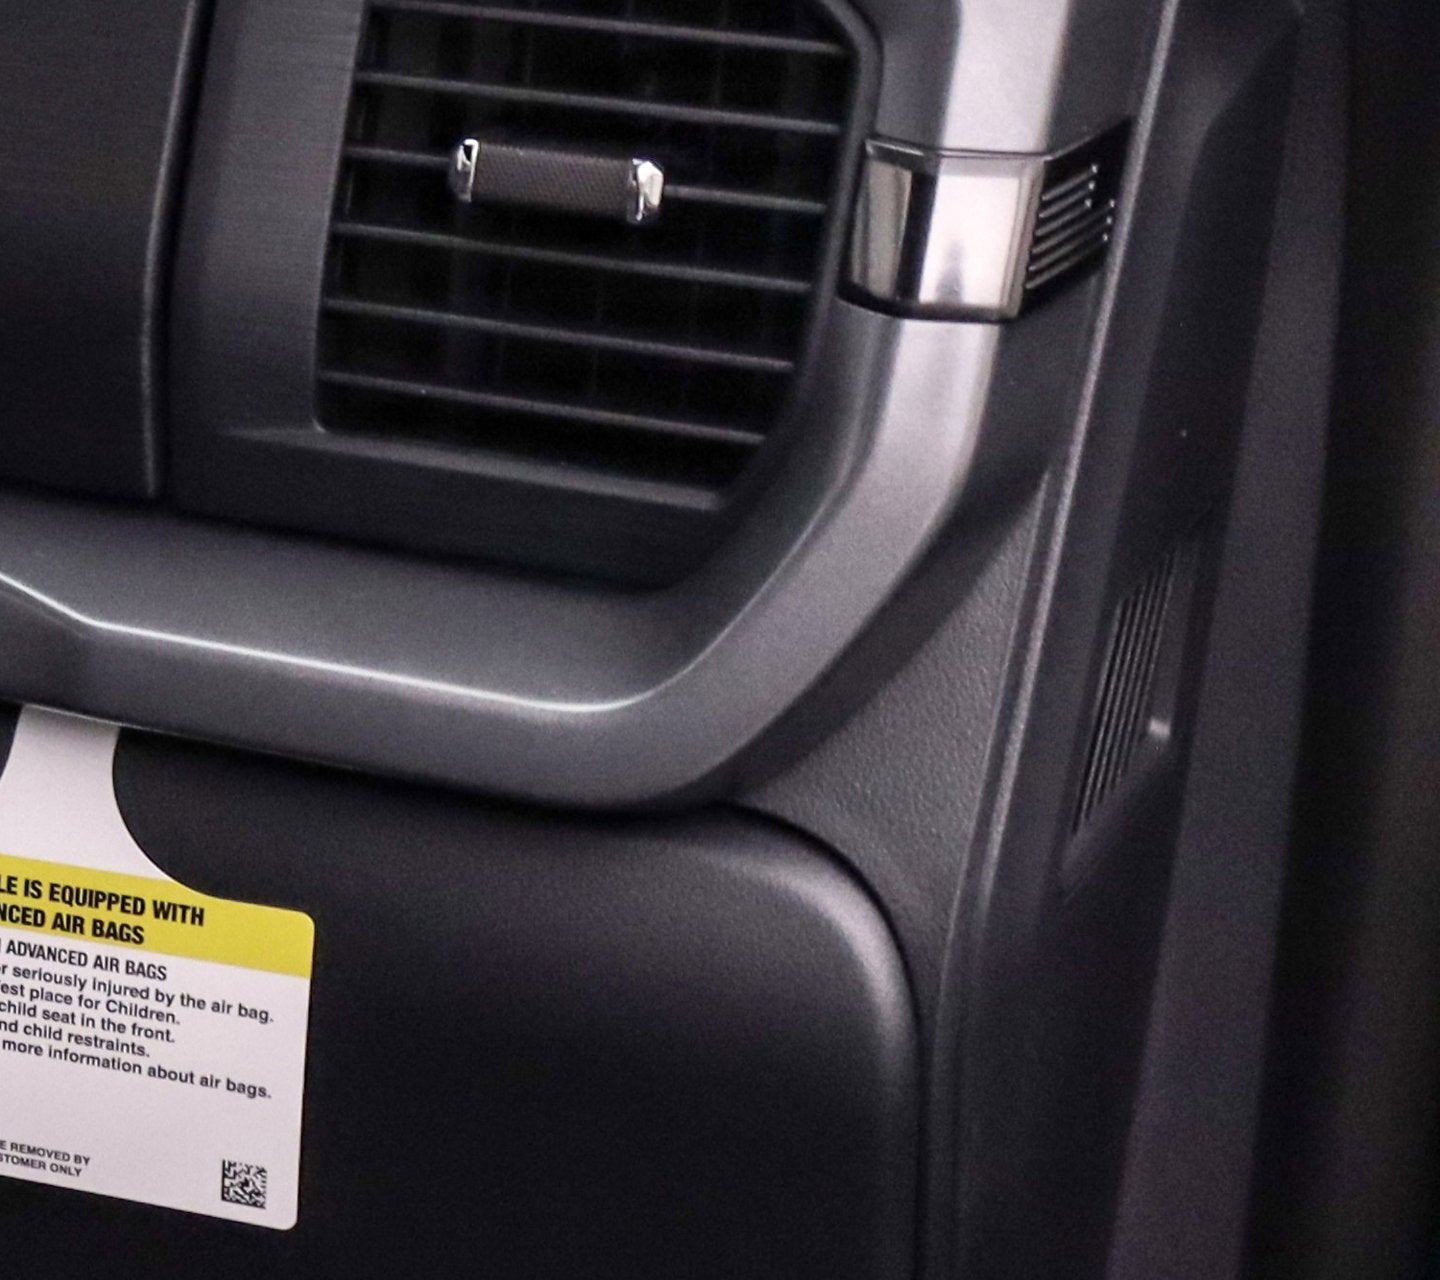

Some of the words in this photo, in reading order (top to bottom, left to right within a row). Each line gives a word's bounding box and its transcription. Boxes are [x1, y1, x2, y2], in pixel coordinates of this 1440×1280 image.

[24, 879, 42, 899] IS
[49, 883, 145, 916] EQUIPPED
[152, 900, 205, 926] WITH
[51, 912, 85, 935] AIR
[91, 918, 144, 945] BAGS
[6, 939, 88, 968] ADVANCED
[93, 954, 120, 974] AIR
[125, 960, 168, 981] BAGS
[12, 964, 88, 992] seriously
[92, 977, 150, 1000] injured
[155, 988, 175, 1007] by
[180, 993, 206, 1010] the
[211, 1000, 233, 1015] air
[238, 1003, 274, 1025] bag.
[29, 986, 73, 1006] place
[77, 996, 101, 1010] for
[106, 999, 181, 1025] Children.
[23, 1023, 63, 1042] child
[67, 1031, 150, 1058] restraints.
[42, 1007, 76, 1026] seat
[81, 1013, 96, 1029] in
[100, 1017, 126, 1034] the
[131, 1022, 176, 1043] front.
[2, 1040, 43, 1057] more
[48, 1045, 142, 1075] information
[147, 1065, 195, 1085] about
[199, 1074, 222, 1089] air
[226, 1077, 272, 1099] bags.
[10, 1141, 70, 1163] REMOVED
[73, 1153, 90, 1166] BY
[50, 1162, 82, 1177] ONLY
